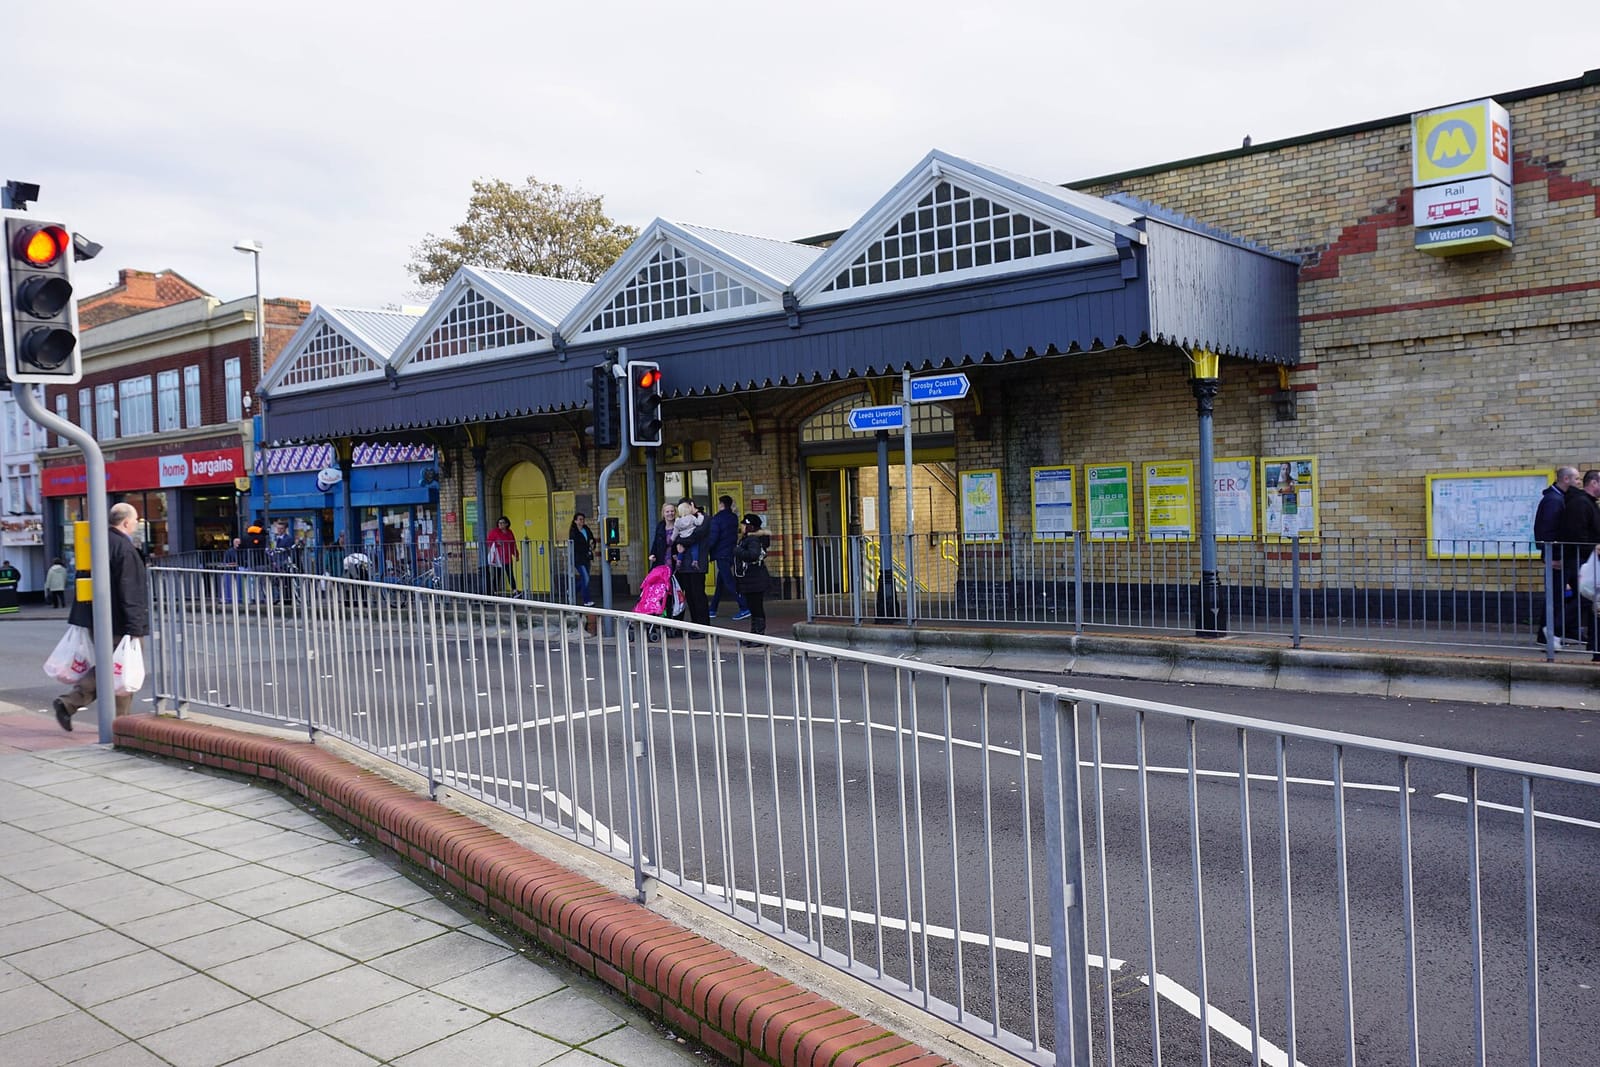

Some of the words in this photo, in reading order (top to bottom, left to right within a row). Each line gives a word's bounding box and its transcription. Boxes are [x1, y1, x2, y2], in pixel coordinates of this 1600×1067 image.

[1445, 186, 1465, 197] Rail
[1429, 227, 1479, 242] Waterloo
[912, 381, 933, 390] Crosby
[934, 379, 958, 388] Coastal
[928, 388, 942, 396] Park
[875, 409, 902, 419] Liverpool
[162, 463, 185, 477] home
[191, 455, 233, 477] bargains
